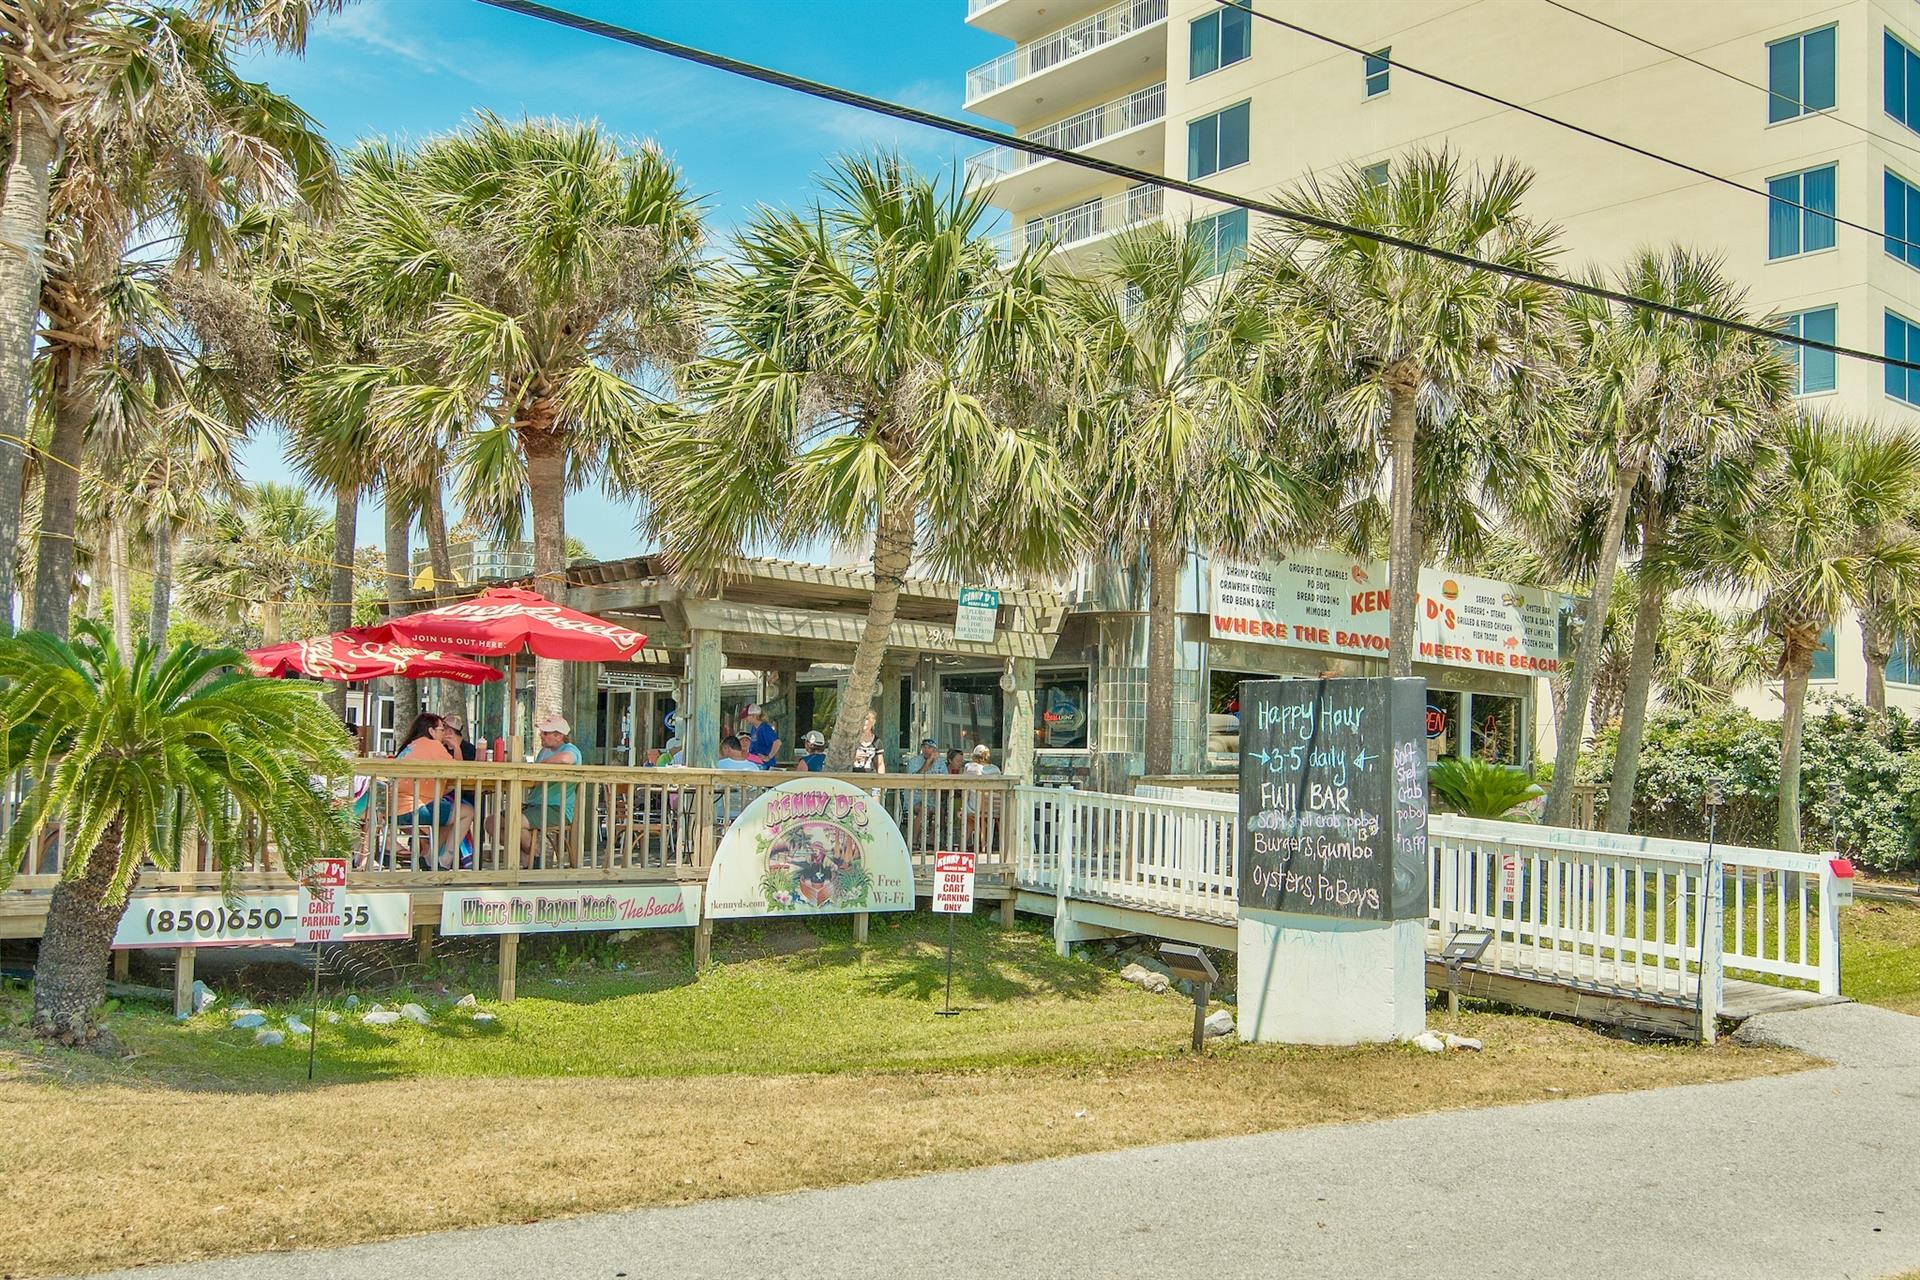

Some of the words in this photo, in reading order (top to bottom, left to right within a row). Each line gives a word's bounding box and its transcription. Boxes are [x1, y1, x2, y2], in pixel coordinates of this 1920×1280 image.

[1226, 566, 1248, 579] SHRIMP
[1250, 570, 1272, 582] CREOLE
[1289, 563, 1314, 577] GROUPER
[1315, 568, 1324, 577] ST.
[1325, 569, 1348, 580] CHARLES
[1220, 580, 1250, 592] CRAWFISH
[1307, 580, 1315, 590] PO
[1316, 581, 1330, 591] BOYS
[1222, 594, 1234, 605] RED
[1235, 596, 1255, 608] BEANS
[1255, 599, 1260, 608] &
[1262, 600, 1275, 610] RICE
[1296, 592, 1316, 602] BREAD
[1316, 594, 1340, 606] PUDDING
[1476, 595, 1496, 605] SEAFOOD
[1306, 606, 1331, 618] MIMOSAS
[1426, 597, 1456, 631] D'S
[1464, 605, 1485, 616] BURGERS
[1490, 609, 1506, 619] STEAKS
[1526, 603, 1541, 614] OYSTER
[1456, 616, 1475, 627] GRILLED
[1476, 619, 1480, 627] &
[1481, 620, 1493, 630] FRIED
[1494, 622, 1513, 633] CHICKEN
[1522, 614, 1534, 625] PASTA
[1473, 630, 1483, 640] FISH
[1484, 632, 1498, 642] TACOS
[1534, 628, 1544, 638] LIME
[411, 634, 437, 643] JOIN
[440, 636, 453, 644] US
[456, 638, 475, 647] OUT
[1214, 615, 1288, 640] WHERE
[1293, 625, 1330, 645] THE
[1419, 642, 1472, 663] MEETS
[1476, 648, 1505, 667] THE
[1509, 654, 1559, 673] BEACH
[1522, 639, 1538, 649] FROZEN
[1538, 640, 1554, 650] DRINKS
[1258, 700, 1314, 740] Happy
[1320, 695, 1365, 735] Hour
[1425, 711, 1446, 732] PEN
[1269, 745, 1305, 773] 3-5
[1309, 745, 1346, 787] daily
[1310, 781, 1351, 814] BAR
[766, 790, 831, 828] KENNY
[834, 794, 869, 827] D'S
[331, 862, 345, 880] D'S
[877, 874, 901, 887] Free
[944, 873, 965, 884] GOLF
[943, 883, 966, 893] CART
[872, 890, 905, 905] Wi-Fi
[937, 893, 970, 903] PARKING
[308, 902, 335, 915] CART
[461, 896, 507, 927] Where
[508, 896, 532, 925] the
[534, 897, 579, 928] Bayou
[580, 894, 617, 923] Meets
[618, 900, 643, 921] The
[643, 893, 685, 918] Beach
[943, 903, 962, 912] ONLY
[146, 905, 370, 936] (850)650-55
[301, 915, 341, 927] PARKING
[309, 929, 331, 941] ONLY
